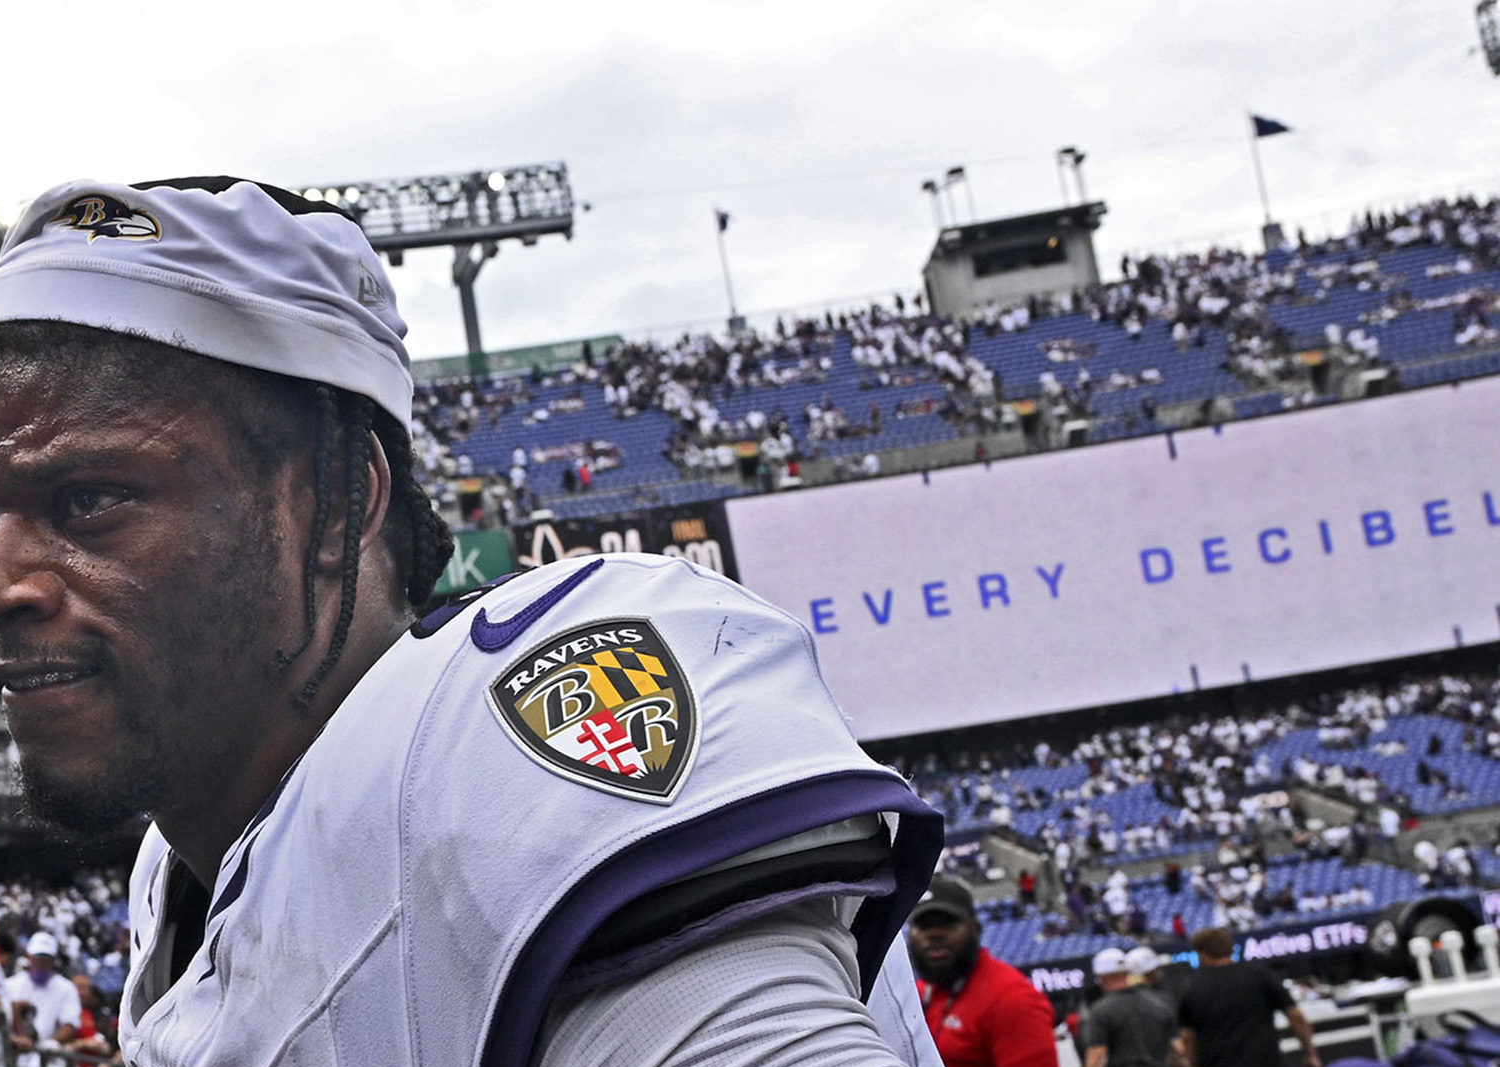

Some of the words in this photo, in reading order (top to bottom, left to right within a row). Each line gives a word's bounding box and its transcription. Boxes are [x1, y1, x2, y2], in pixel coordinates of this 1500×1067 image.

[810, 563, 1065, 634] EVERY
[504, 629, 644, 696] RAVENS
[520, 668, 596, 736] B
[614, 697, 678, 755] R
[1243, 932, 1311, 961] Active
[1312, 921, 1367, 951] ETFs
